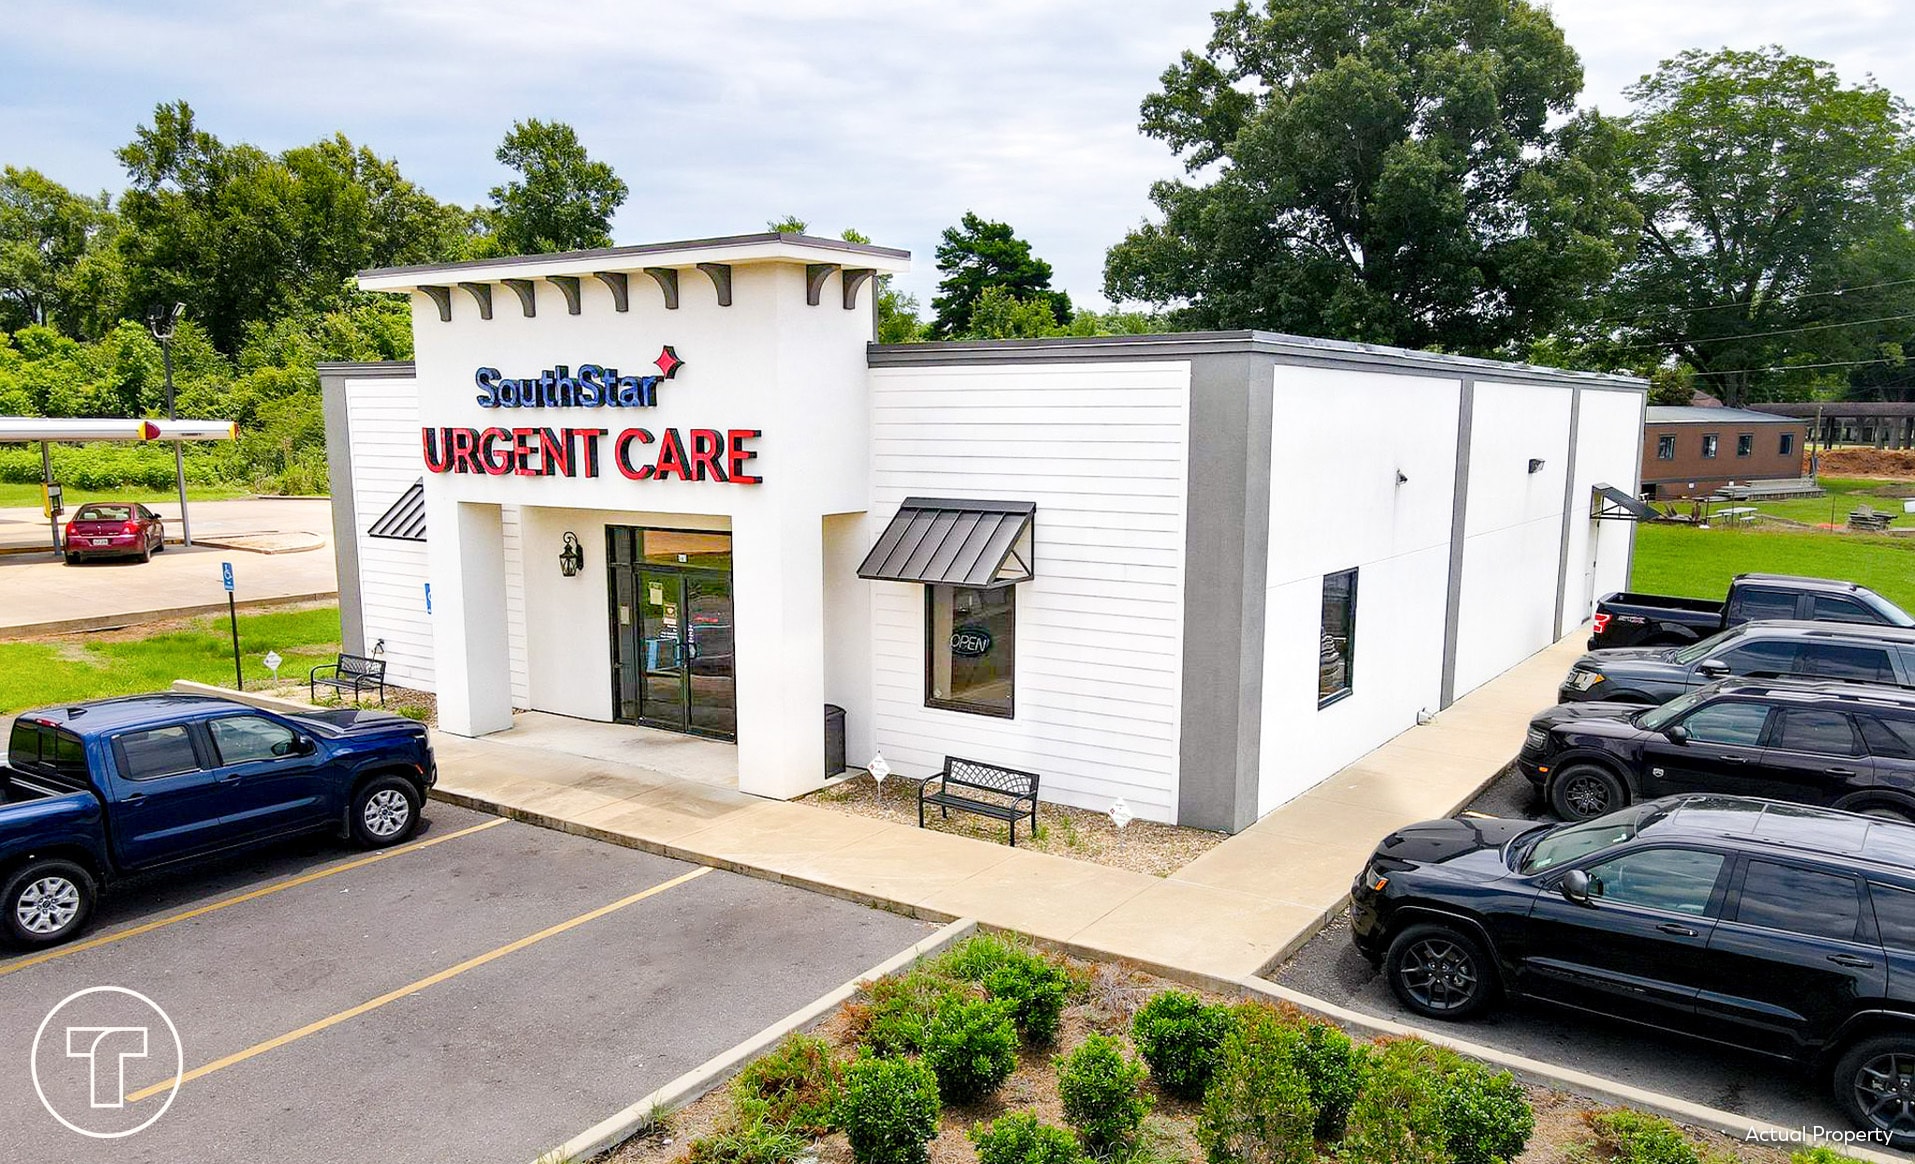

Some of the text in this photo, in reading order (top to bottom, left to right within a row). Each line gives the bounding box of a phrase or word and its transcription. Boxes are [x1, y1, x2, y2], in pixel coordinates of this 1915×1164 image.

[475, 364, 664, 408] SouthStar
[422, 427, 763, 484] URGENT CARE
[950, 633, 987, 652] OPEN
